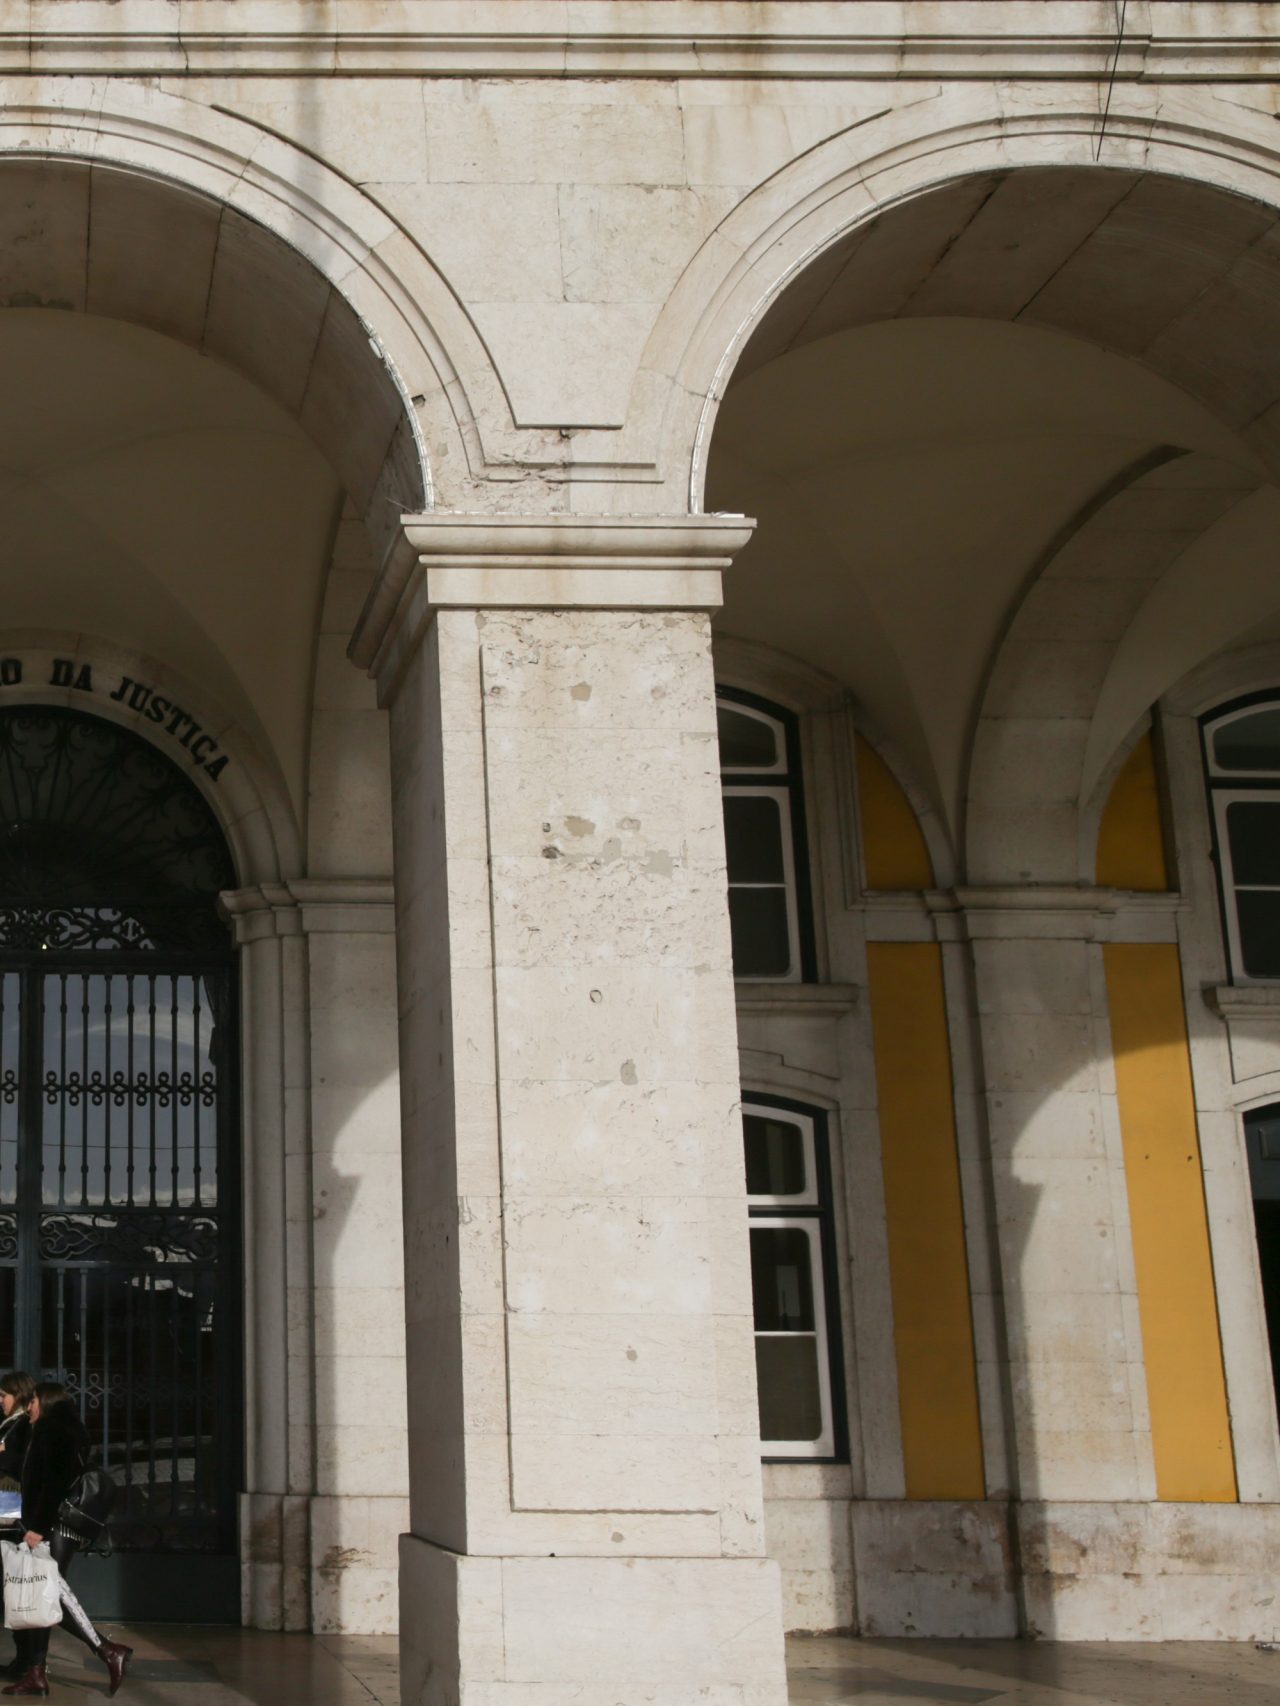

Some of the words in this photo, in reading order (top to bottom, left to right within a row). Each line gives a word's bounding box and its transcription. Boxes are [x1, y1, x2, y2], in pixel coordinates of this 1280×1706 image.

[49, 659, 93, 692] DA
[110, 676, 230, 782] JUSTIÇA
[7, 1573, 48, 1584] straivarius
